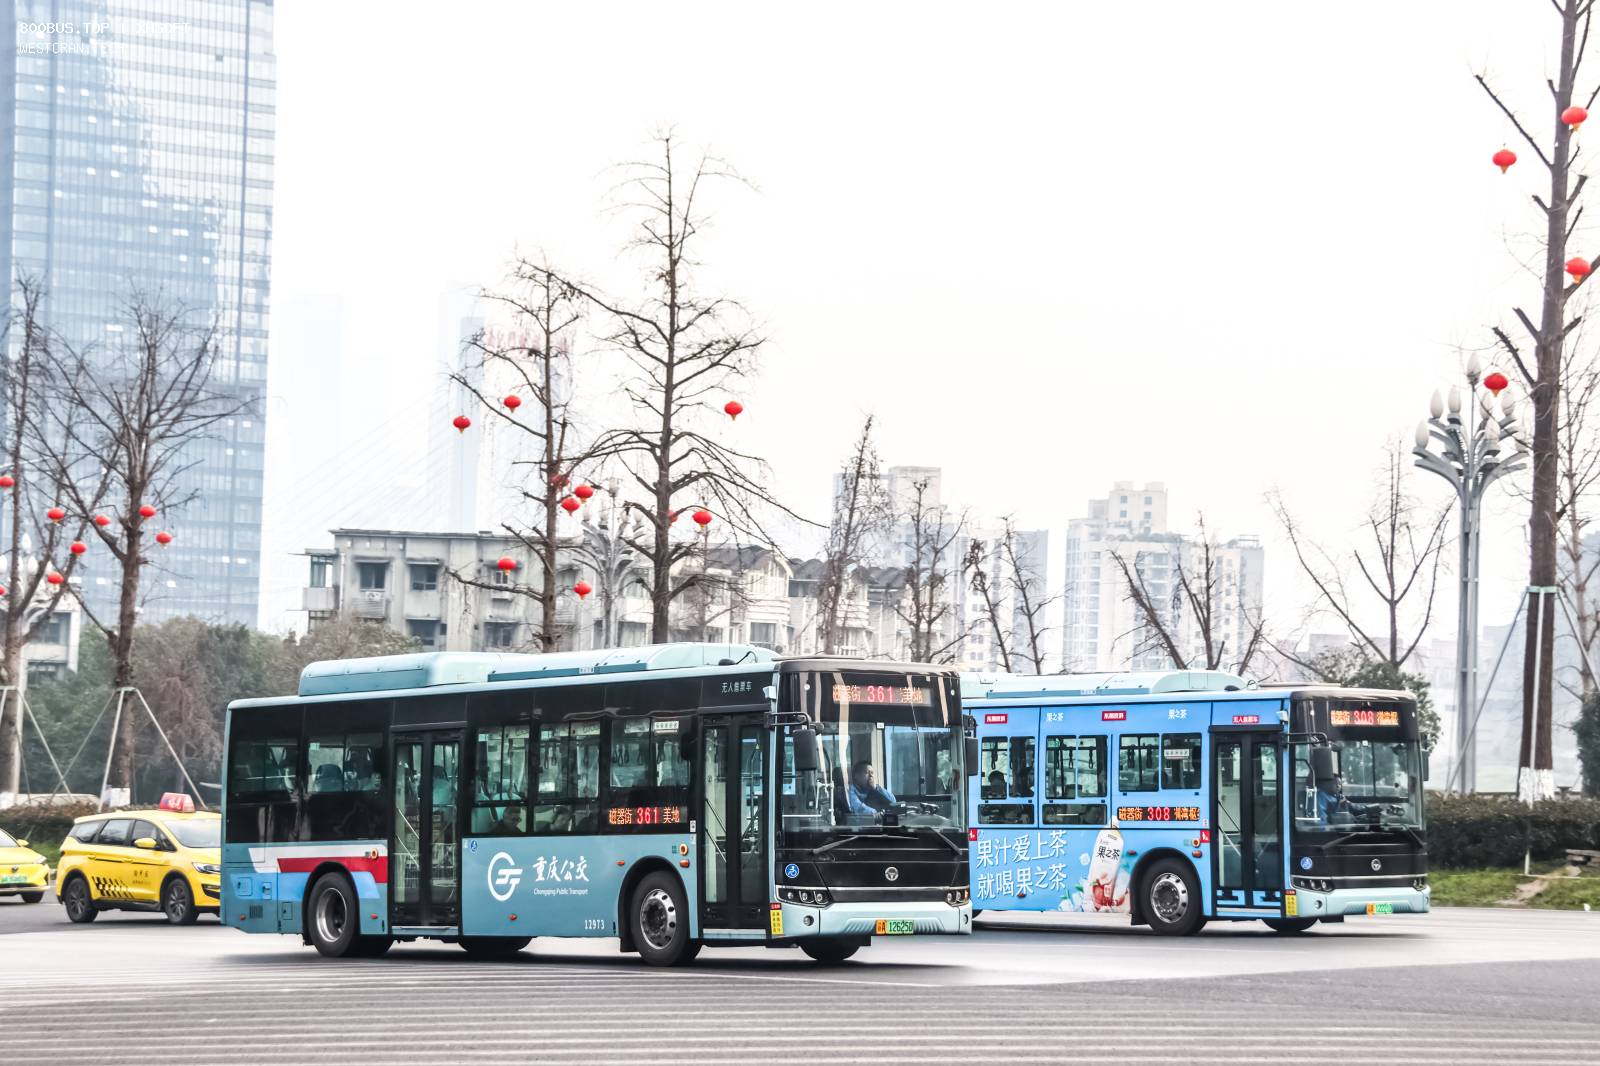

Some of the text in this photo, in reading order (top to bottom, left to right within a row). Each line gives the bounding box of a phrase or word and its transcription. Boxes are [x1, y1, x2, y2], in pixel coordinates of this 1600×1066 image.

[867, 686, 894, 703] 361
[1168, 709, 1188, 719] 果之茶
[1354, 710, 1374, 725] 308
[608, 806, 680, 824] 磁器街 361 美地
[1118, 807, 1143, 821] 磁器街
[1147, 807, 1170, 821] 308
[976, 829, 1068, 869] 果汁爱上茶
[1097, 845, 1120, 861] 果之茶
[532, 855, 590, 882] 重庆公交
[977, 863, 1068, 901] 就喝果之茶
[556, 887, 569, 895] Public
[569, 887, 589, 897] Transport
[584, 919, 605, 930] 12973
